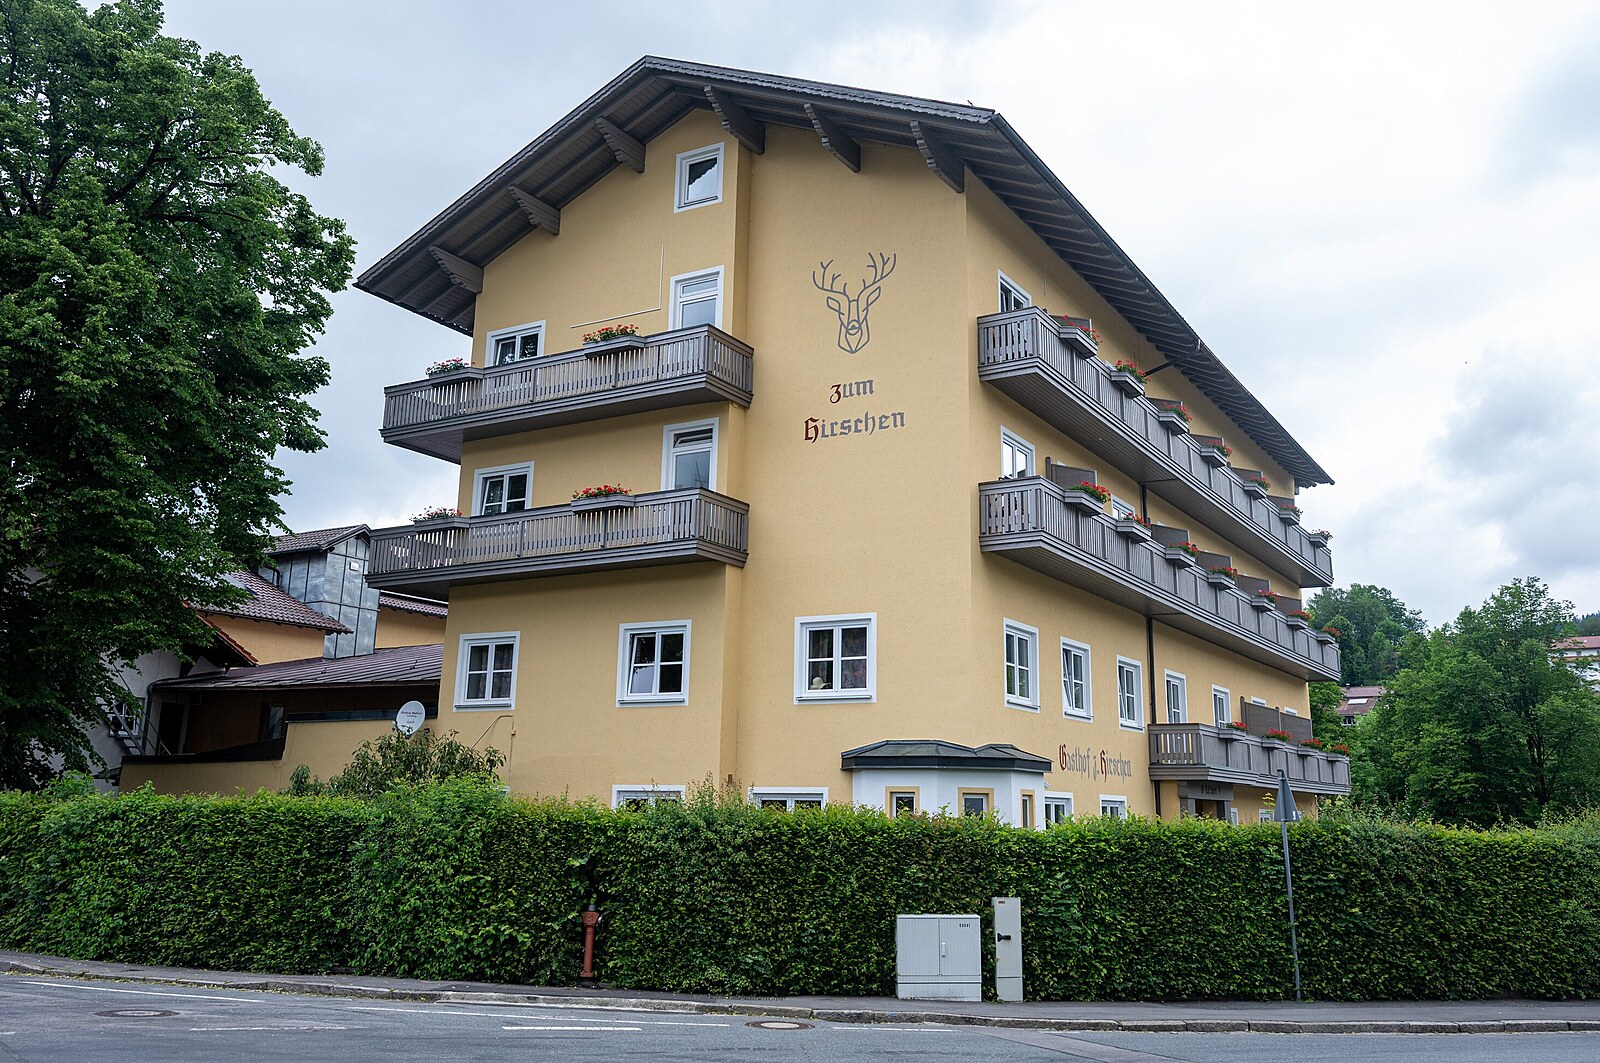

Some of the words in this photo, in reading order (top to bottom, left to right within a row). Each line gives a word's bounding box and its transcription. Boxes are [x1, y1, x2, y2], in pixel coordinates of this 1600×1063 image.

[804, 411, 905, 443] Hirschen
[1059, 743, 1090, 780] Gasthof
[1100, 749, 1132, 784] Hirschen
